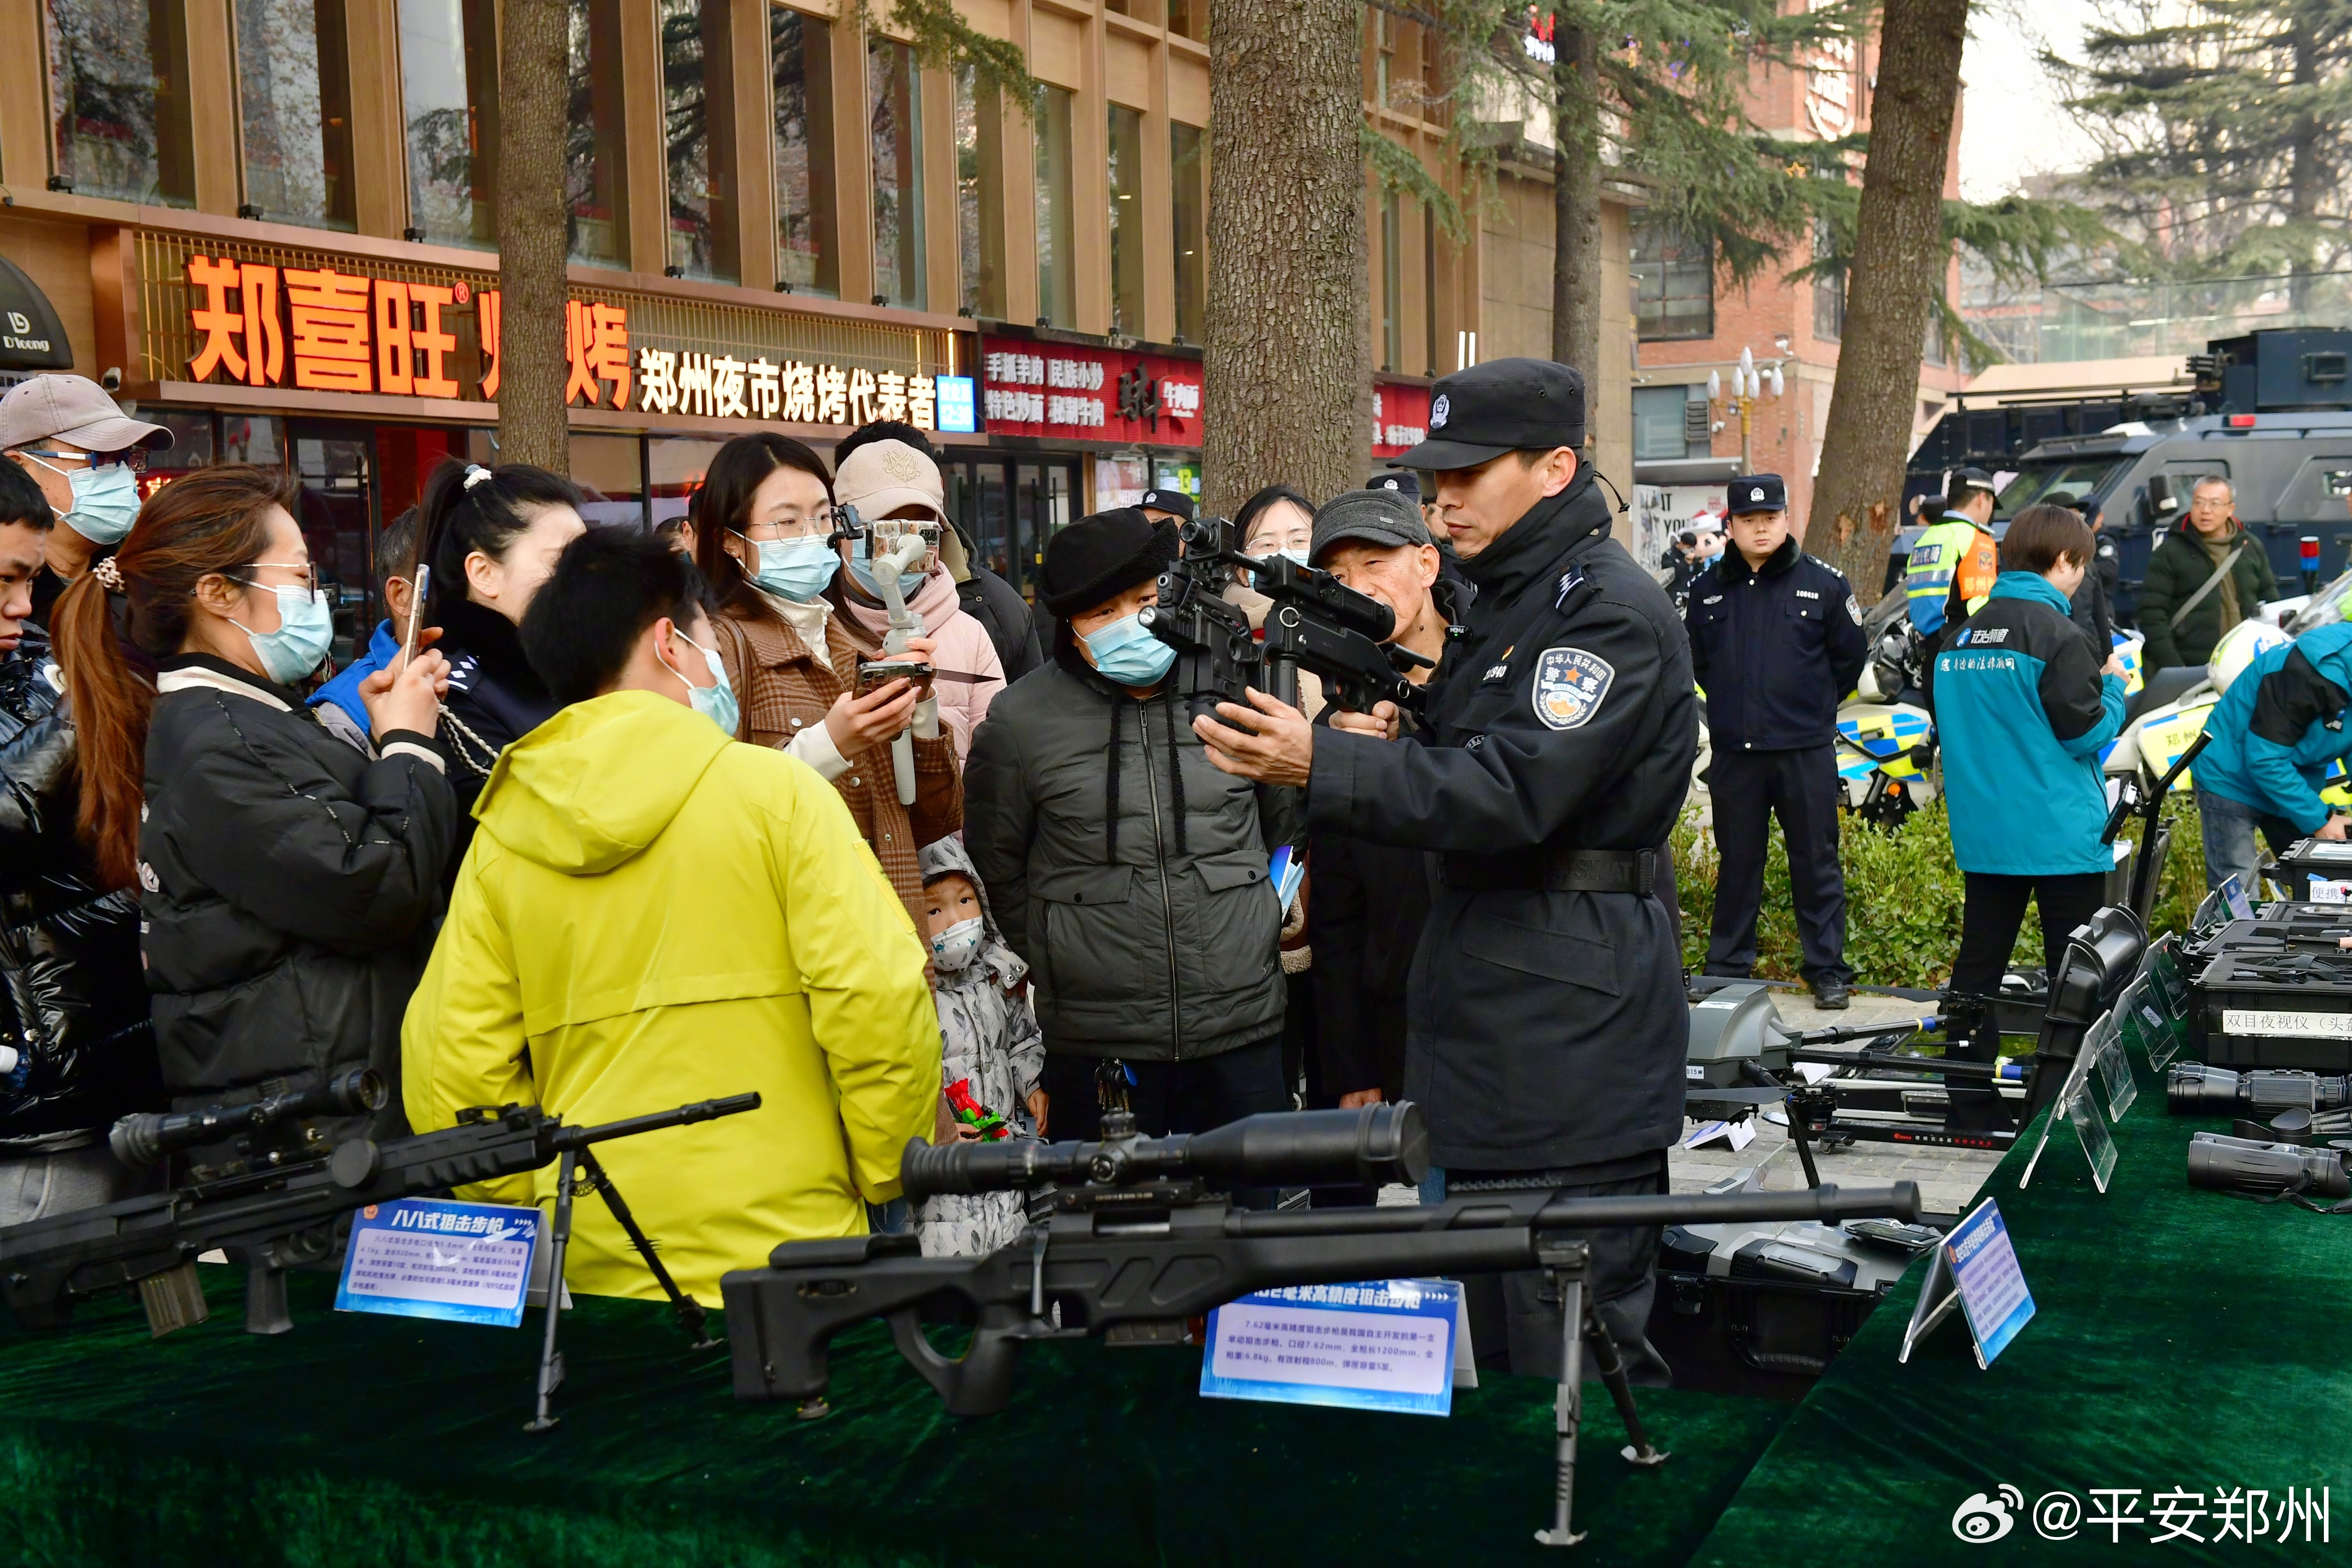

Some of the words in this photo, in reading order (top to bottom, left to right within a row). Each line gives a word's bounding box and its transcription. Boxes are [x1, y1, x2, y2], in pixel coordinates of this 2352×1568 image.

[189, 254, 459, 398] 郑喜旺
[987, 352, 1044, 385] 手抓羊肉
[1048, 359, 1104, 391] 民族小炒
[639, 346, 936, 431] 郑州夜市烧烤代表者
[985, 389, 1044, 423] 特色炒面
[1544, 667, 1561, 682] 警
[1581, 676, 1599, 693] 察
[1546, 653, 1607, 681] 中华人民共和国
[1554, 684, 1581, 696] POLICE
[391, 1209, 505, 1235] 八八式狙击步枪
